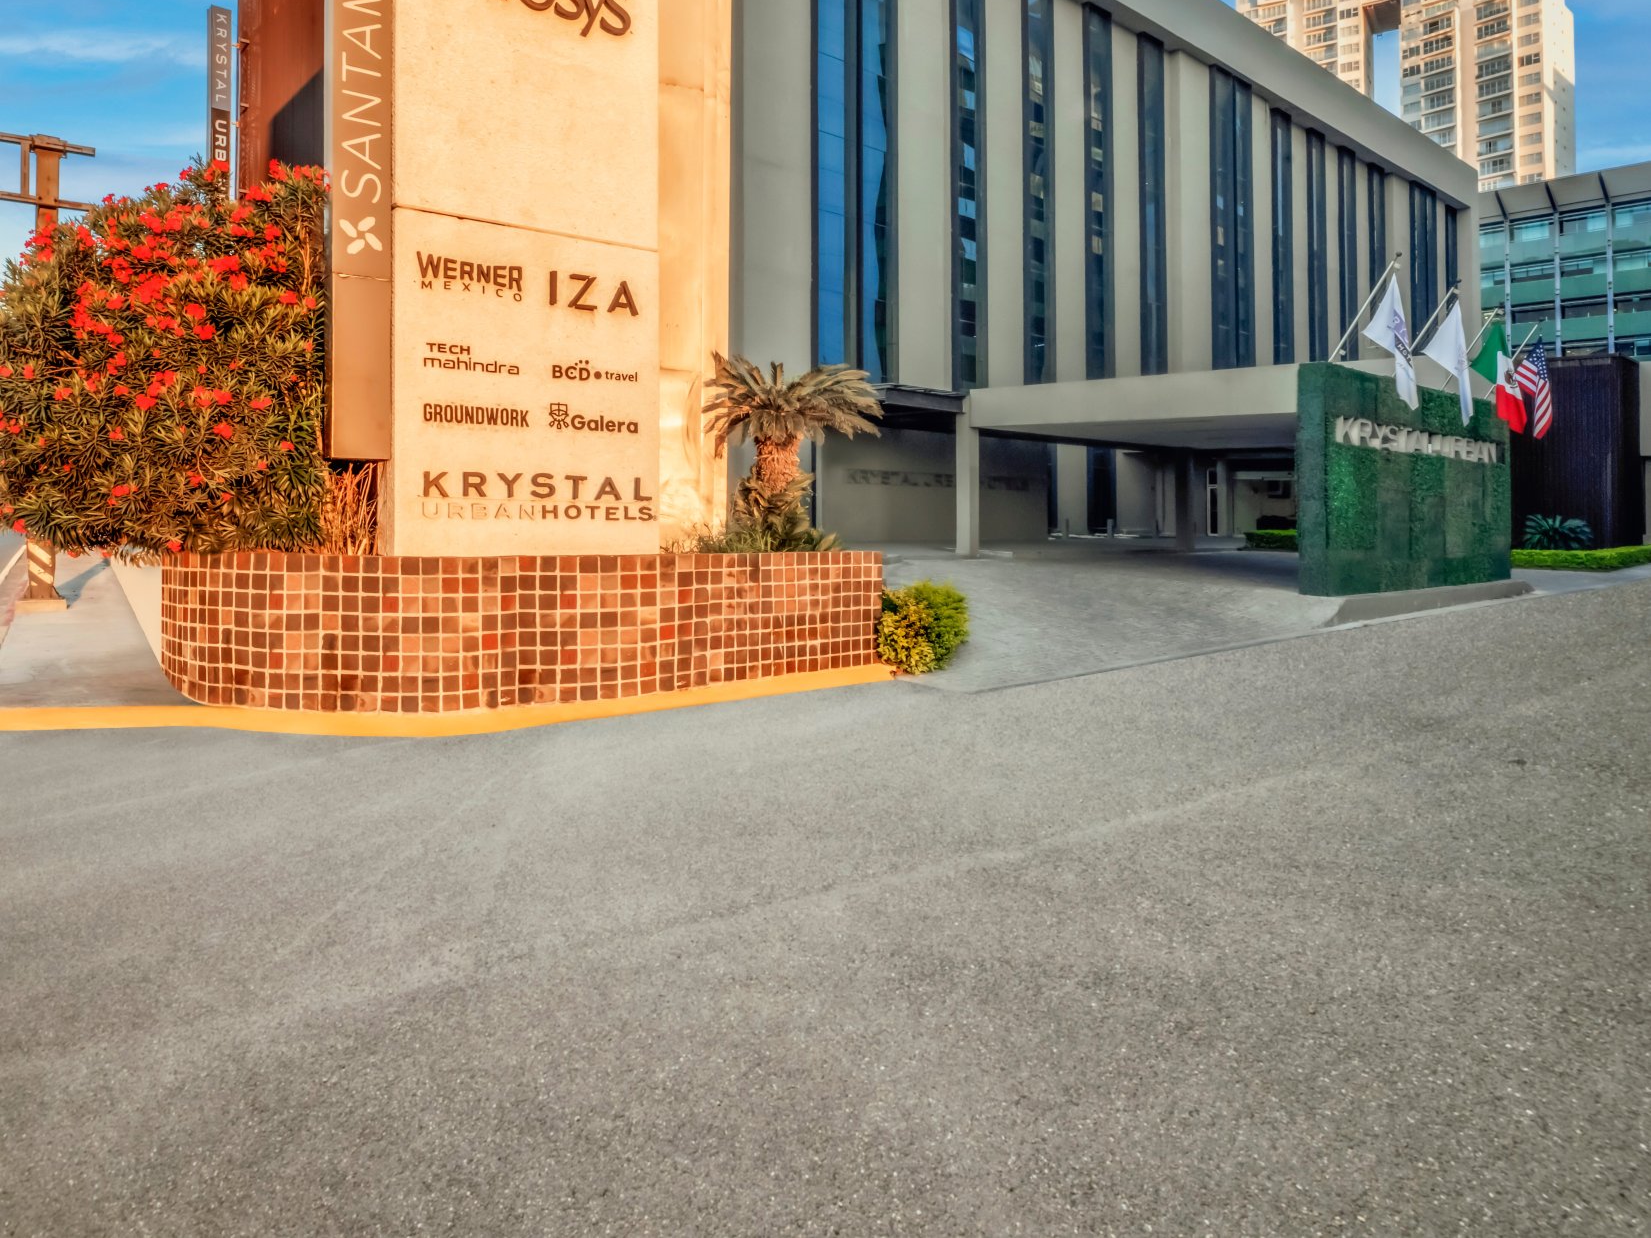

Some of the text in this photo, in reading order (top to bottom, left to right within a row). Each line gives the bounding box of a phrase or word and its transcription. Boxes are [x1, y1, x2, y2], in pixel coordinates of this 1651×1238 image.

[215, 13, 227, 102] KRYSTAL
[214, 119, 227, 174] URB
[416, 251, 523, 292] WERNER
[421, 280, 522, 302] MEXICO
[549, 270, 639, 317] IZA
[426, 342, 471, 356] TECH
[423, 357, 520, 375] mahindra
[605, 370, 638, 382] travel
[423, 402, 530, 428] GROUNDWORK
[570, 413, 639, 434] Galera
[423, 470, 653, 501] KRYSTAL
